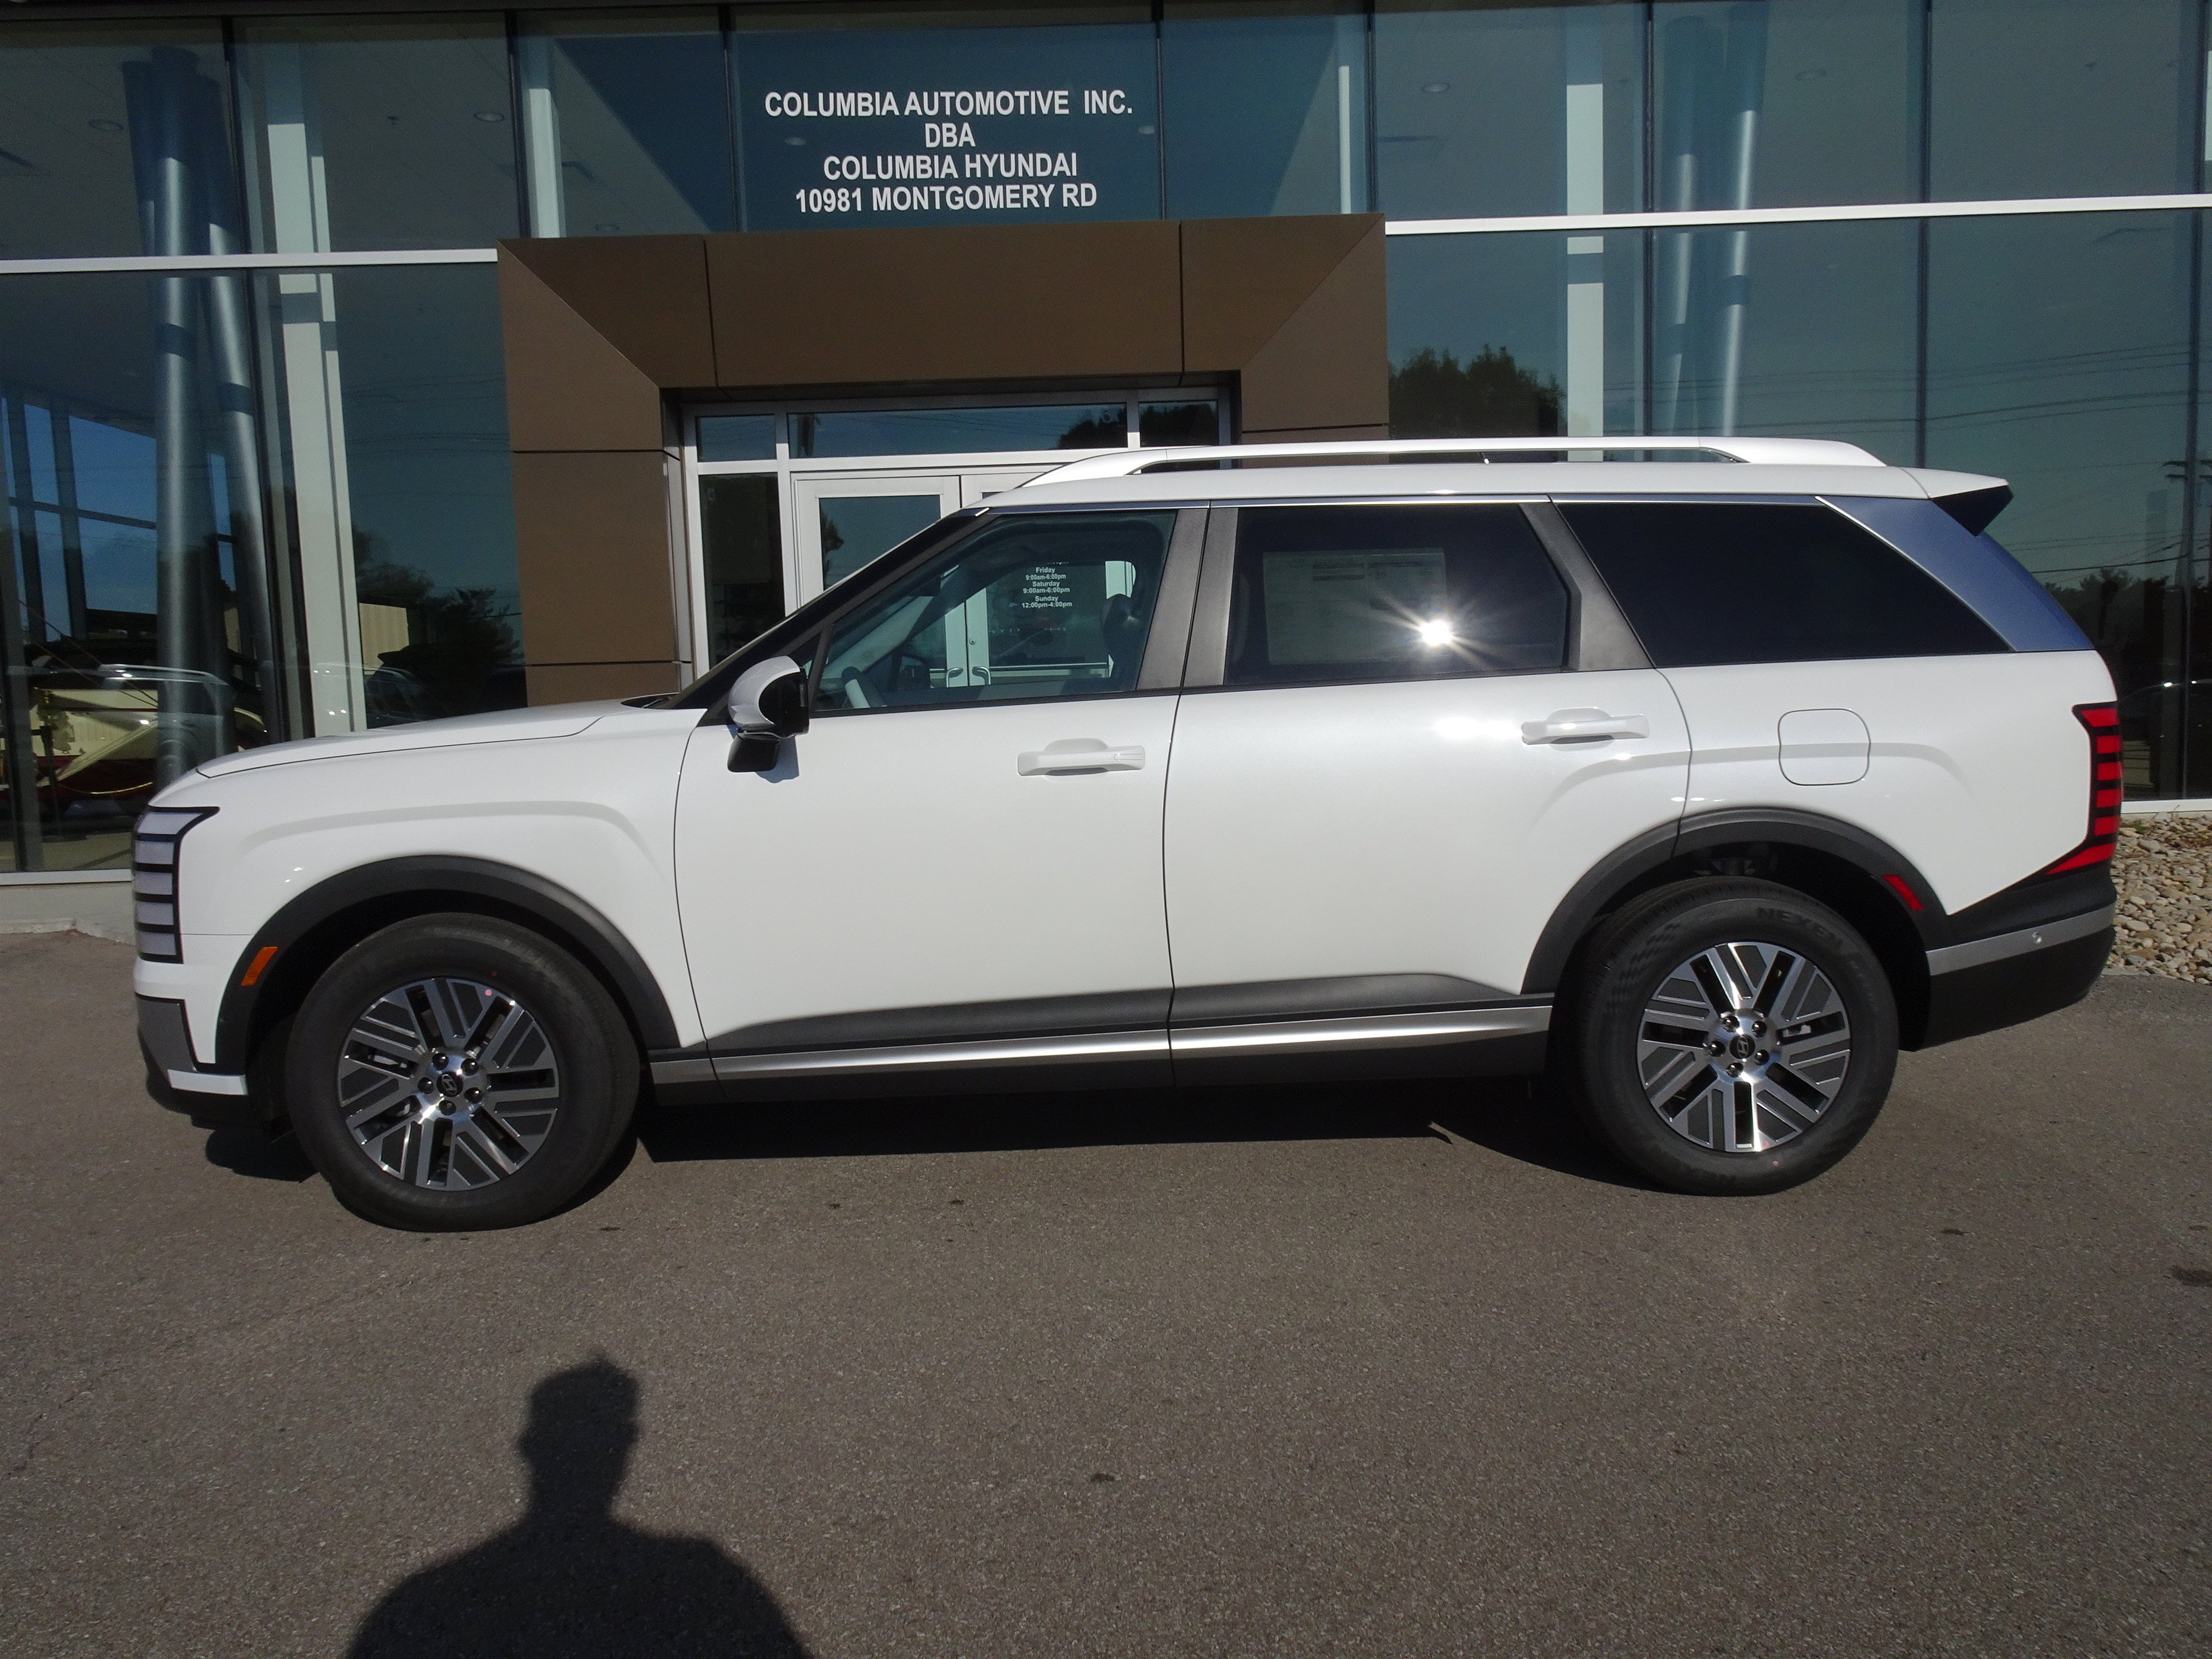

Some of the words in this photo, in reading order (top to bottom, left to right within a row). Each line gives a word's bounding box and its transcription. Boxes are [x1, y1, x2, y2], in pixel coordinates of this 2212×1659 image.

[765, 91, 900, 117] COLUMBIA
[904, 90, 1069, 116] AUTOMOTIVE
[1084, 90, 1133, 115] INC.
[925, 122, 976, 148] DBA
[823, 154, 959, 180] COLUMBIA
[965, 152, 1077, 178] HYUNDAI
[796, 188, 862, 213] 10981
[872, 184, 1055, 211] MONTGOMERY
[1062, 183, 1097, 207] RD
[1756, 907, 1844, 950] NEXEN
